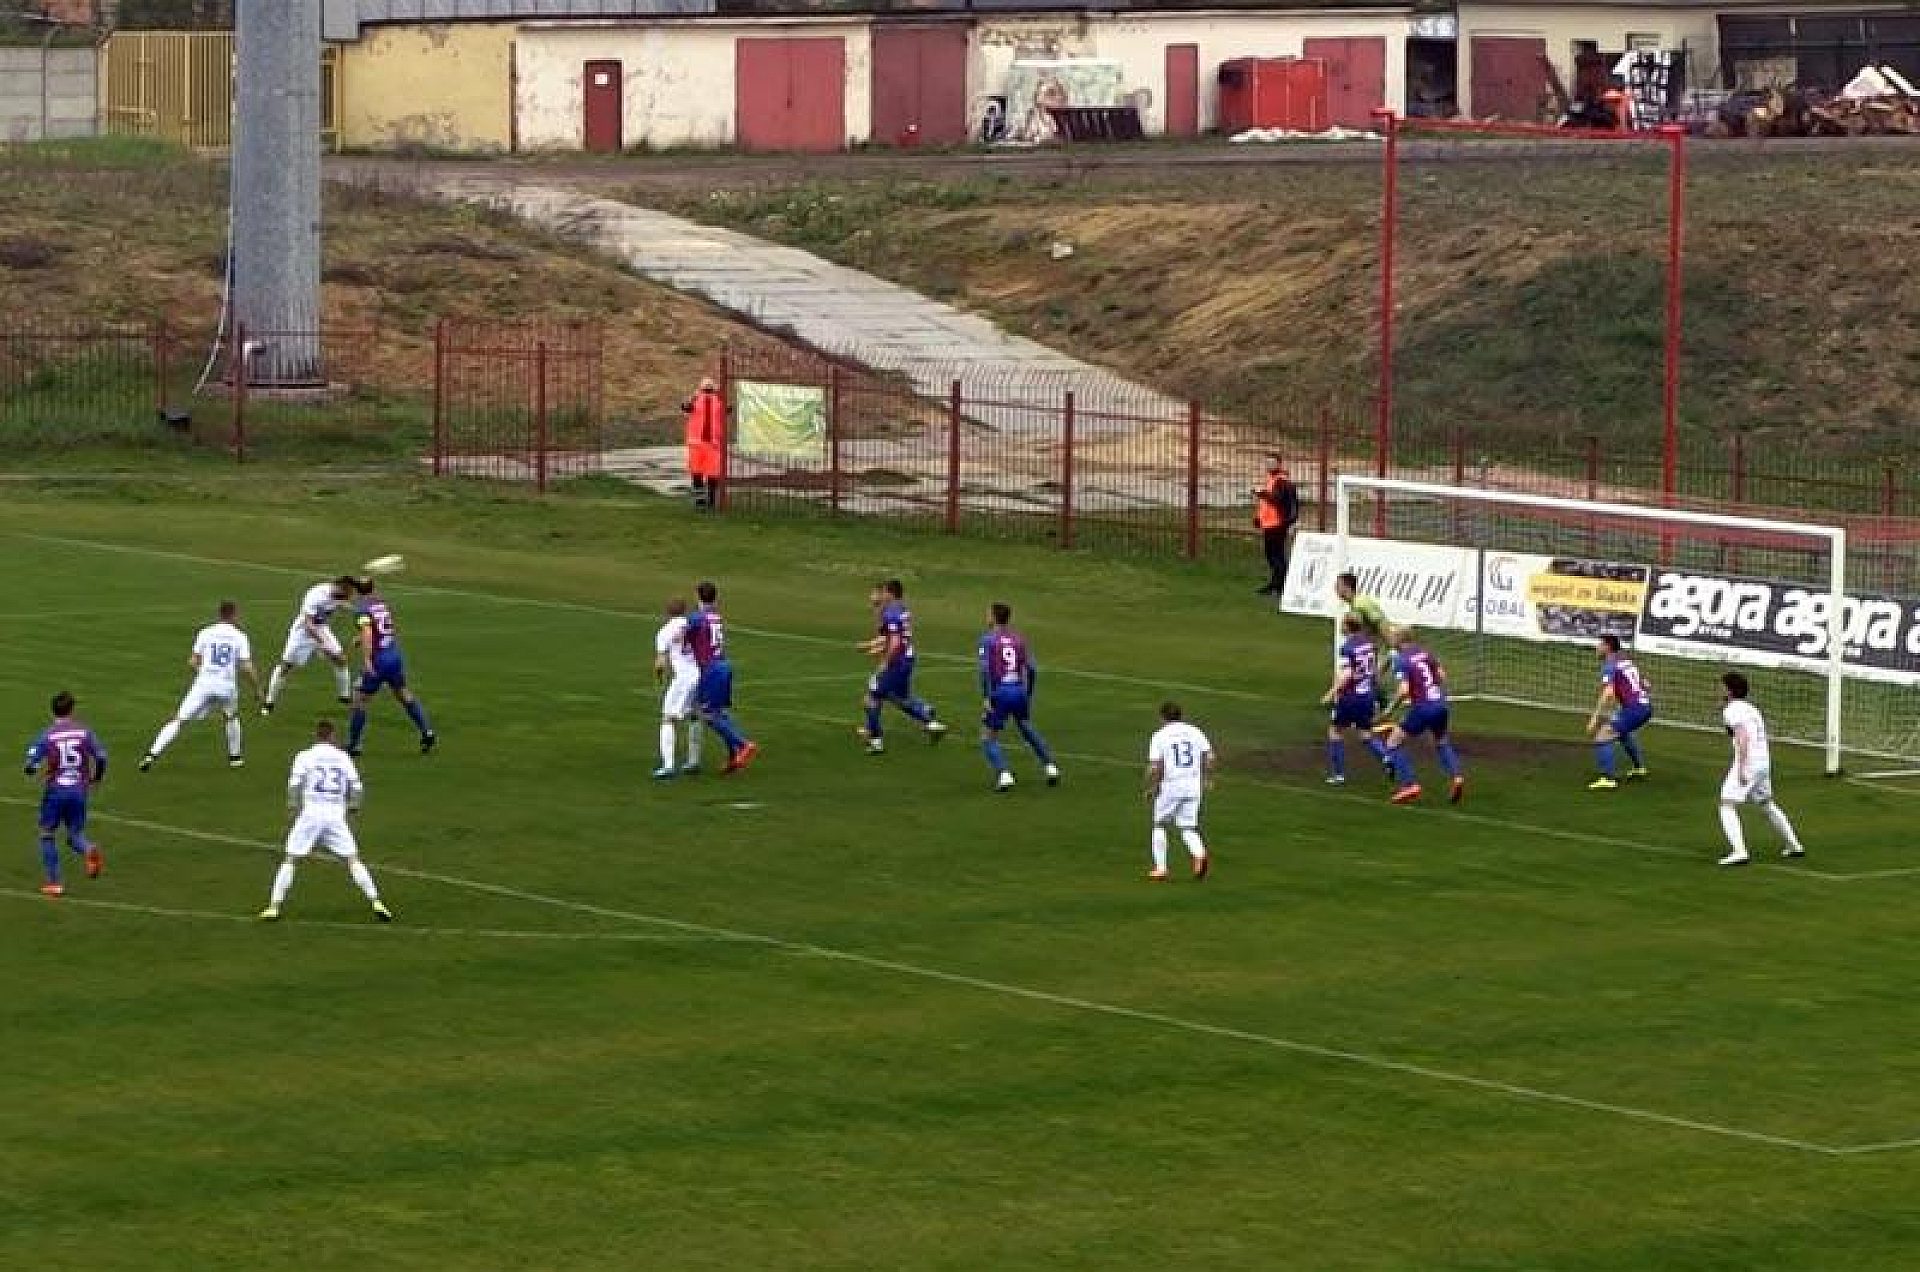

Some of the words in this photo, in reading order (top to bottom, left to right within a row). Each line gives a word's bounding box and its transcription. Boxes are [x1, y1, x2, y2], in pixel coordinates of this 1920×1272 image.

[1650, 573, 1771, 635] agora
[209, 642, 232, 668] 18
[1002, 647, 1016, 671] 9
[57, 740, 82, 768] 15
[1170, 741, 1194, 769] 13
[312, 766, 343, 795] 23
